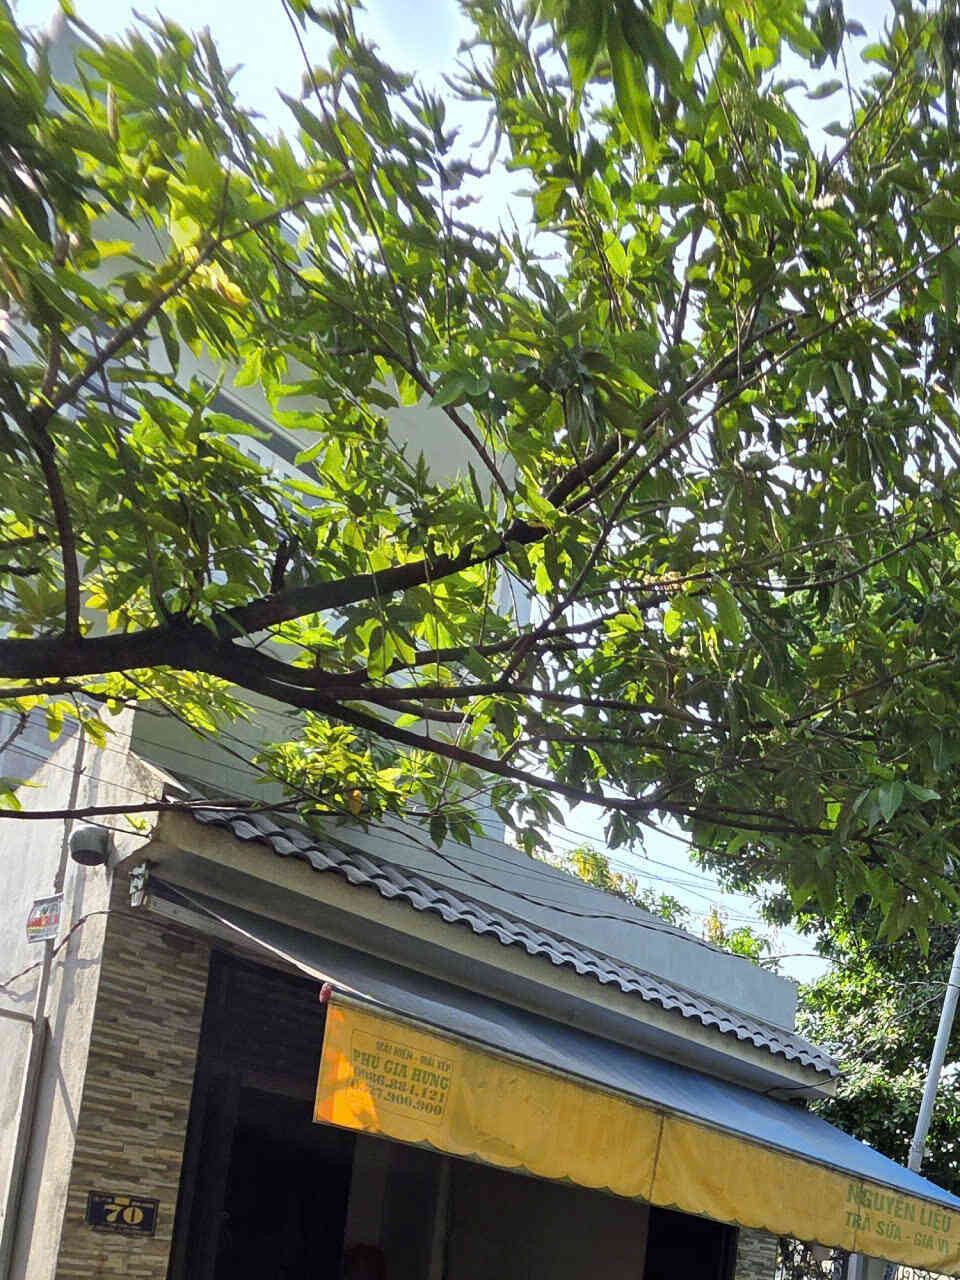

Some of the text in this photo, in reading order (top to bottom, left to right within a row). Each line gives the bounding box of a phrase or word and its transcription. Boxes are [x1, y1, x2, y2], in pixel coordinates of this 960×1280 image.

[383, 1059, 408, 1078] GIA
[104, 1203, 144, 1225] 70
[914, 1231, 934, 1249] GIA
